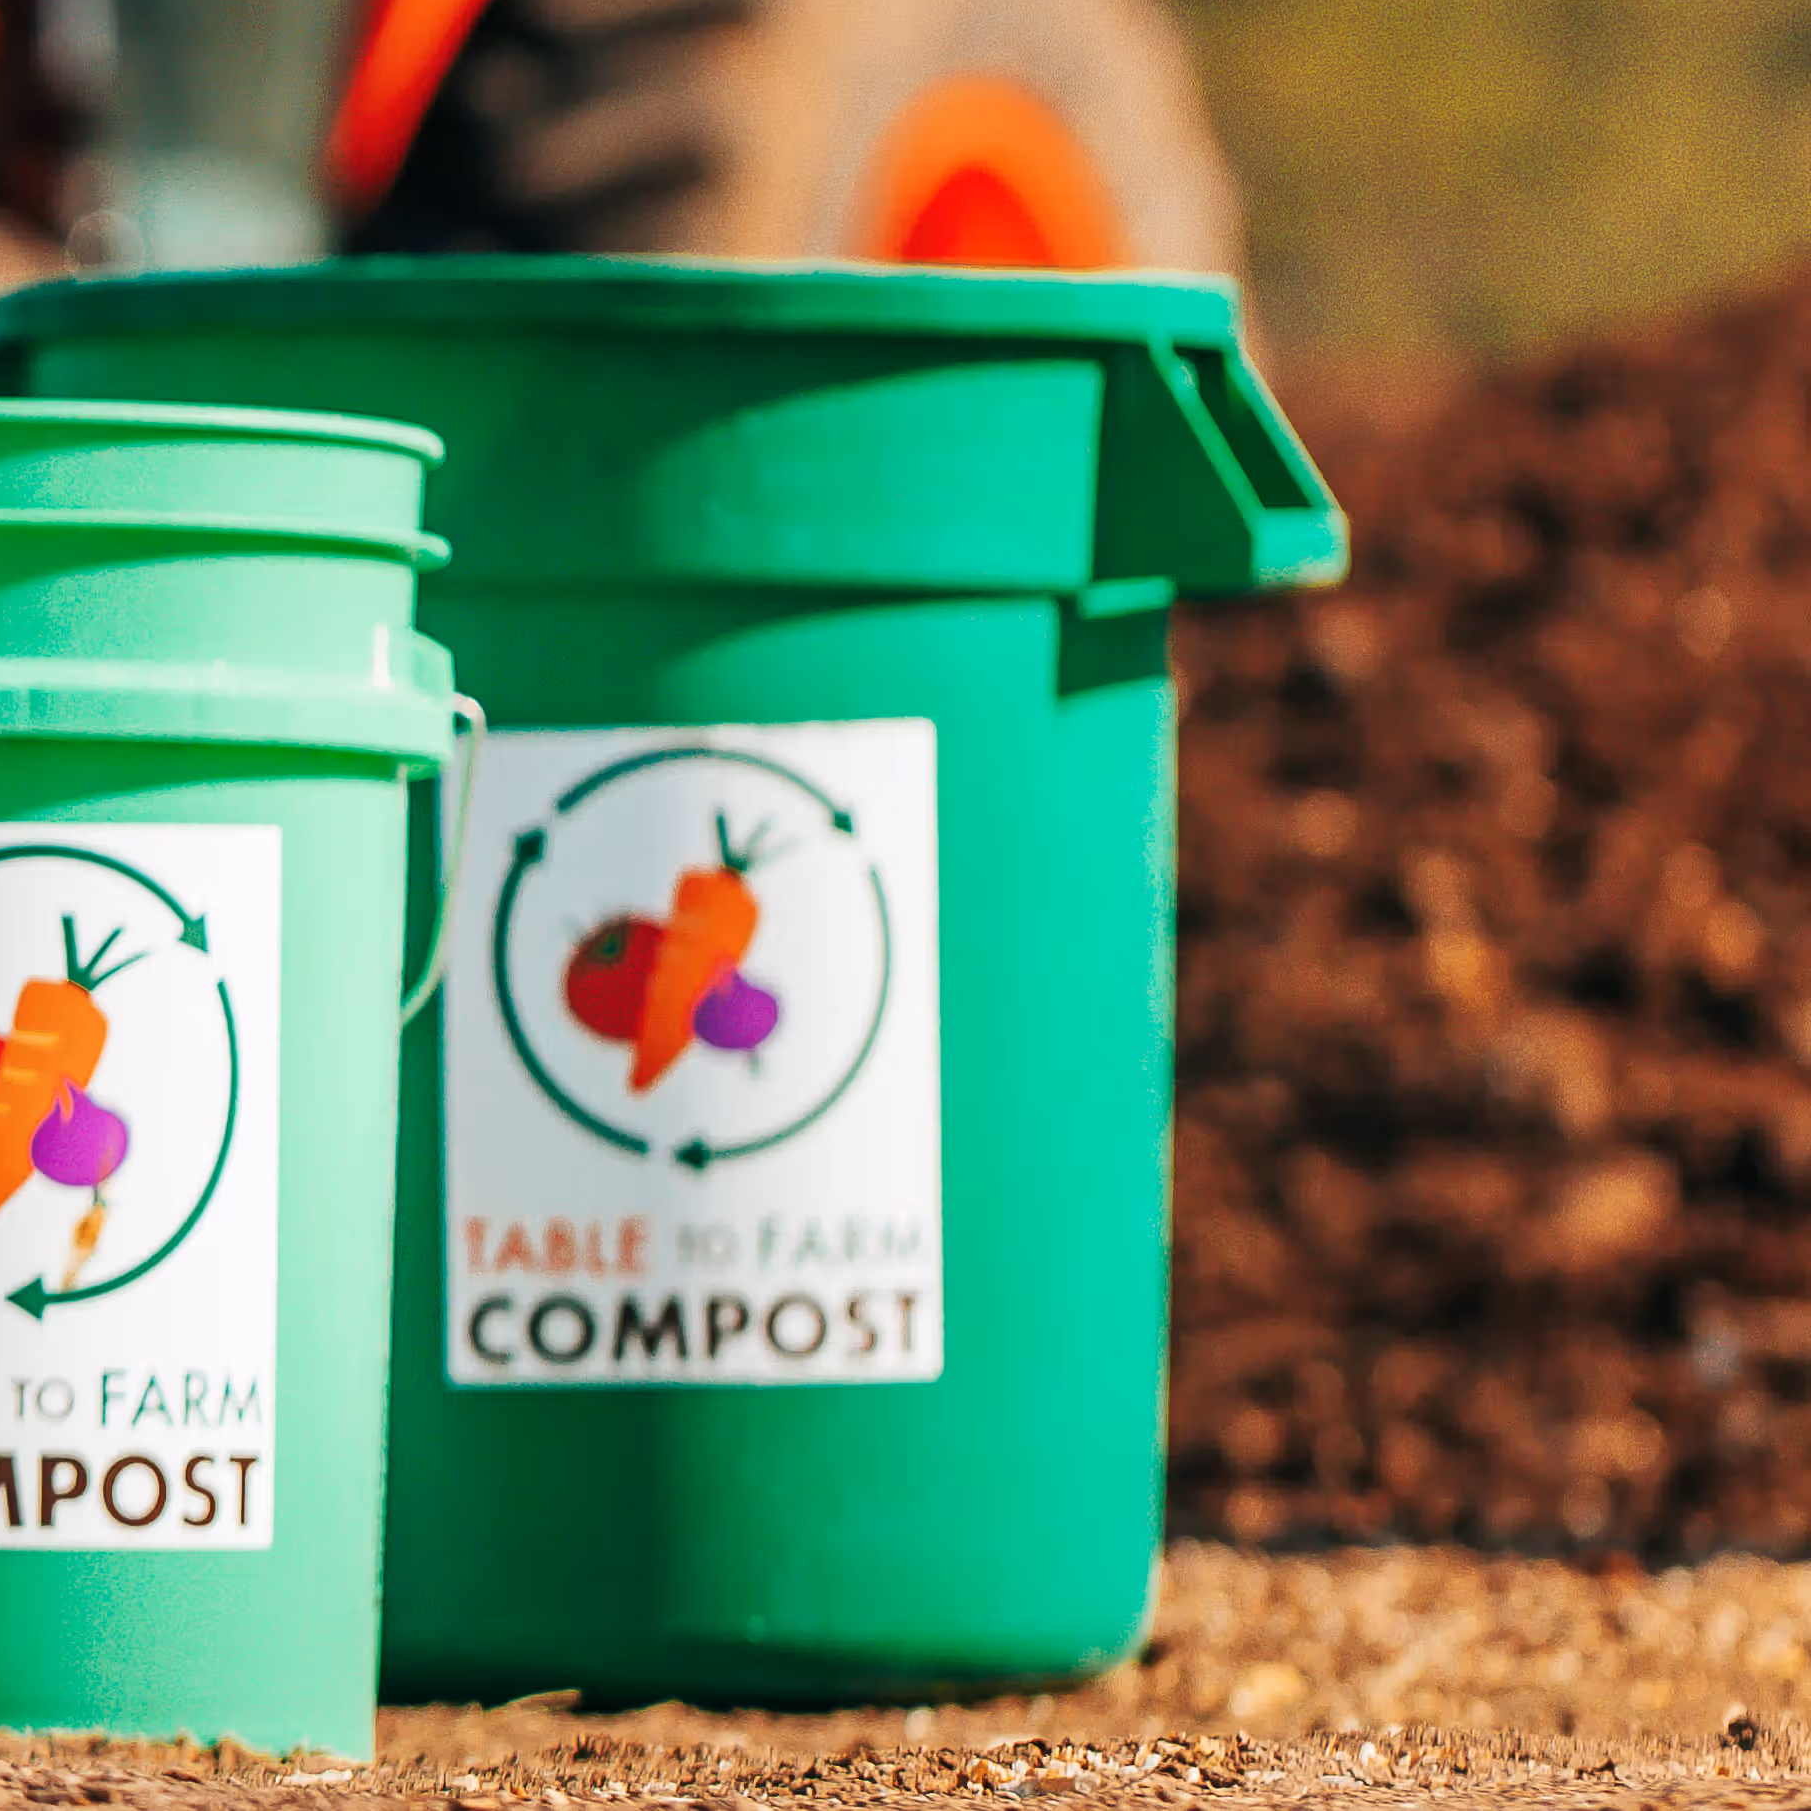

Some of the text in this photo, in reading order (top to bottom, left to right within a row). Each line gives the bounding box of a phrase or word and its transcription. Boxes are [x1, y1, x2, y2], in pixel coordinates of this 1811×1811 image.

[467, 1290, 918, 1364] COMPOST
[11, 1375, 75, 1420] TO
[97, 1368, 263, 1427] FARM
